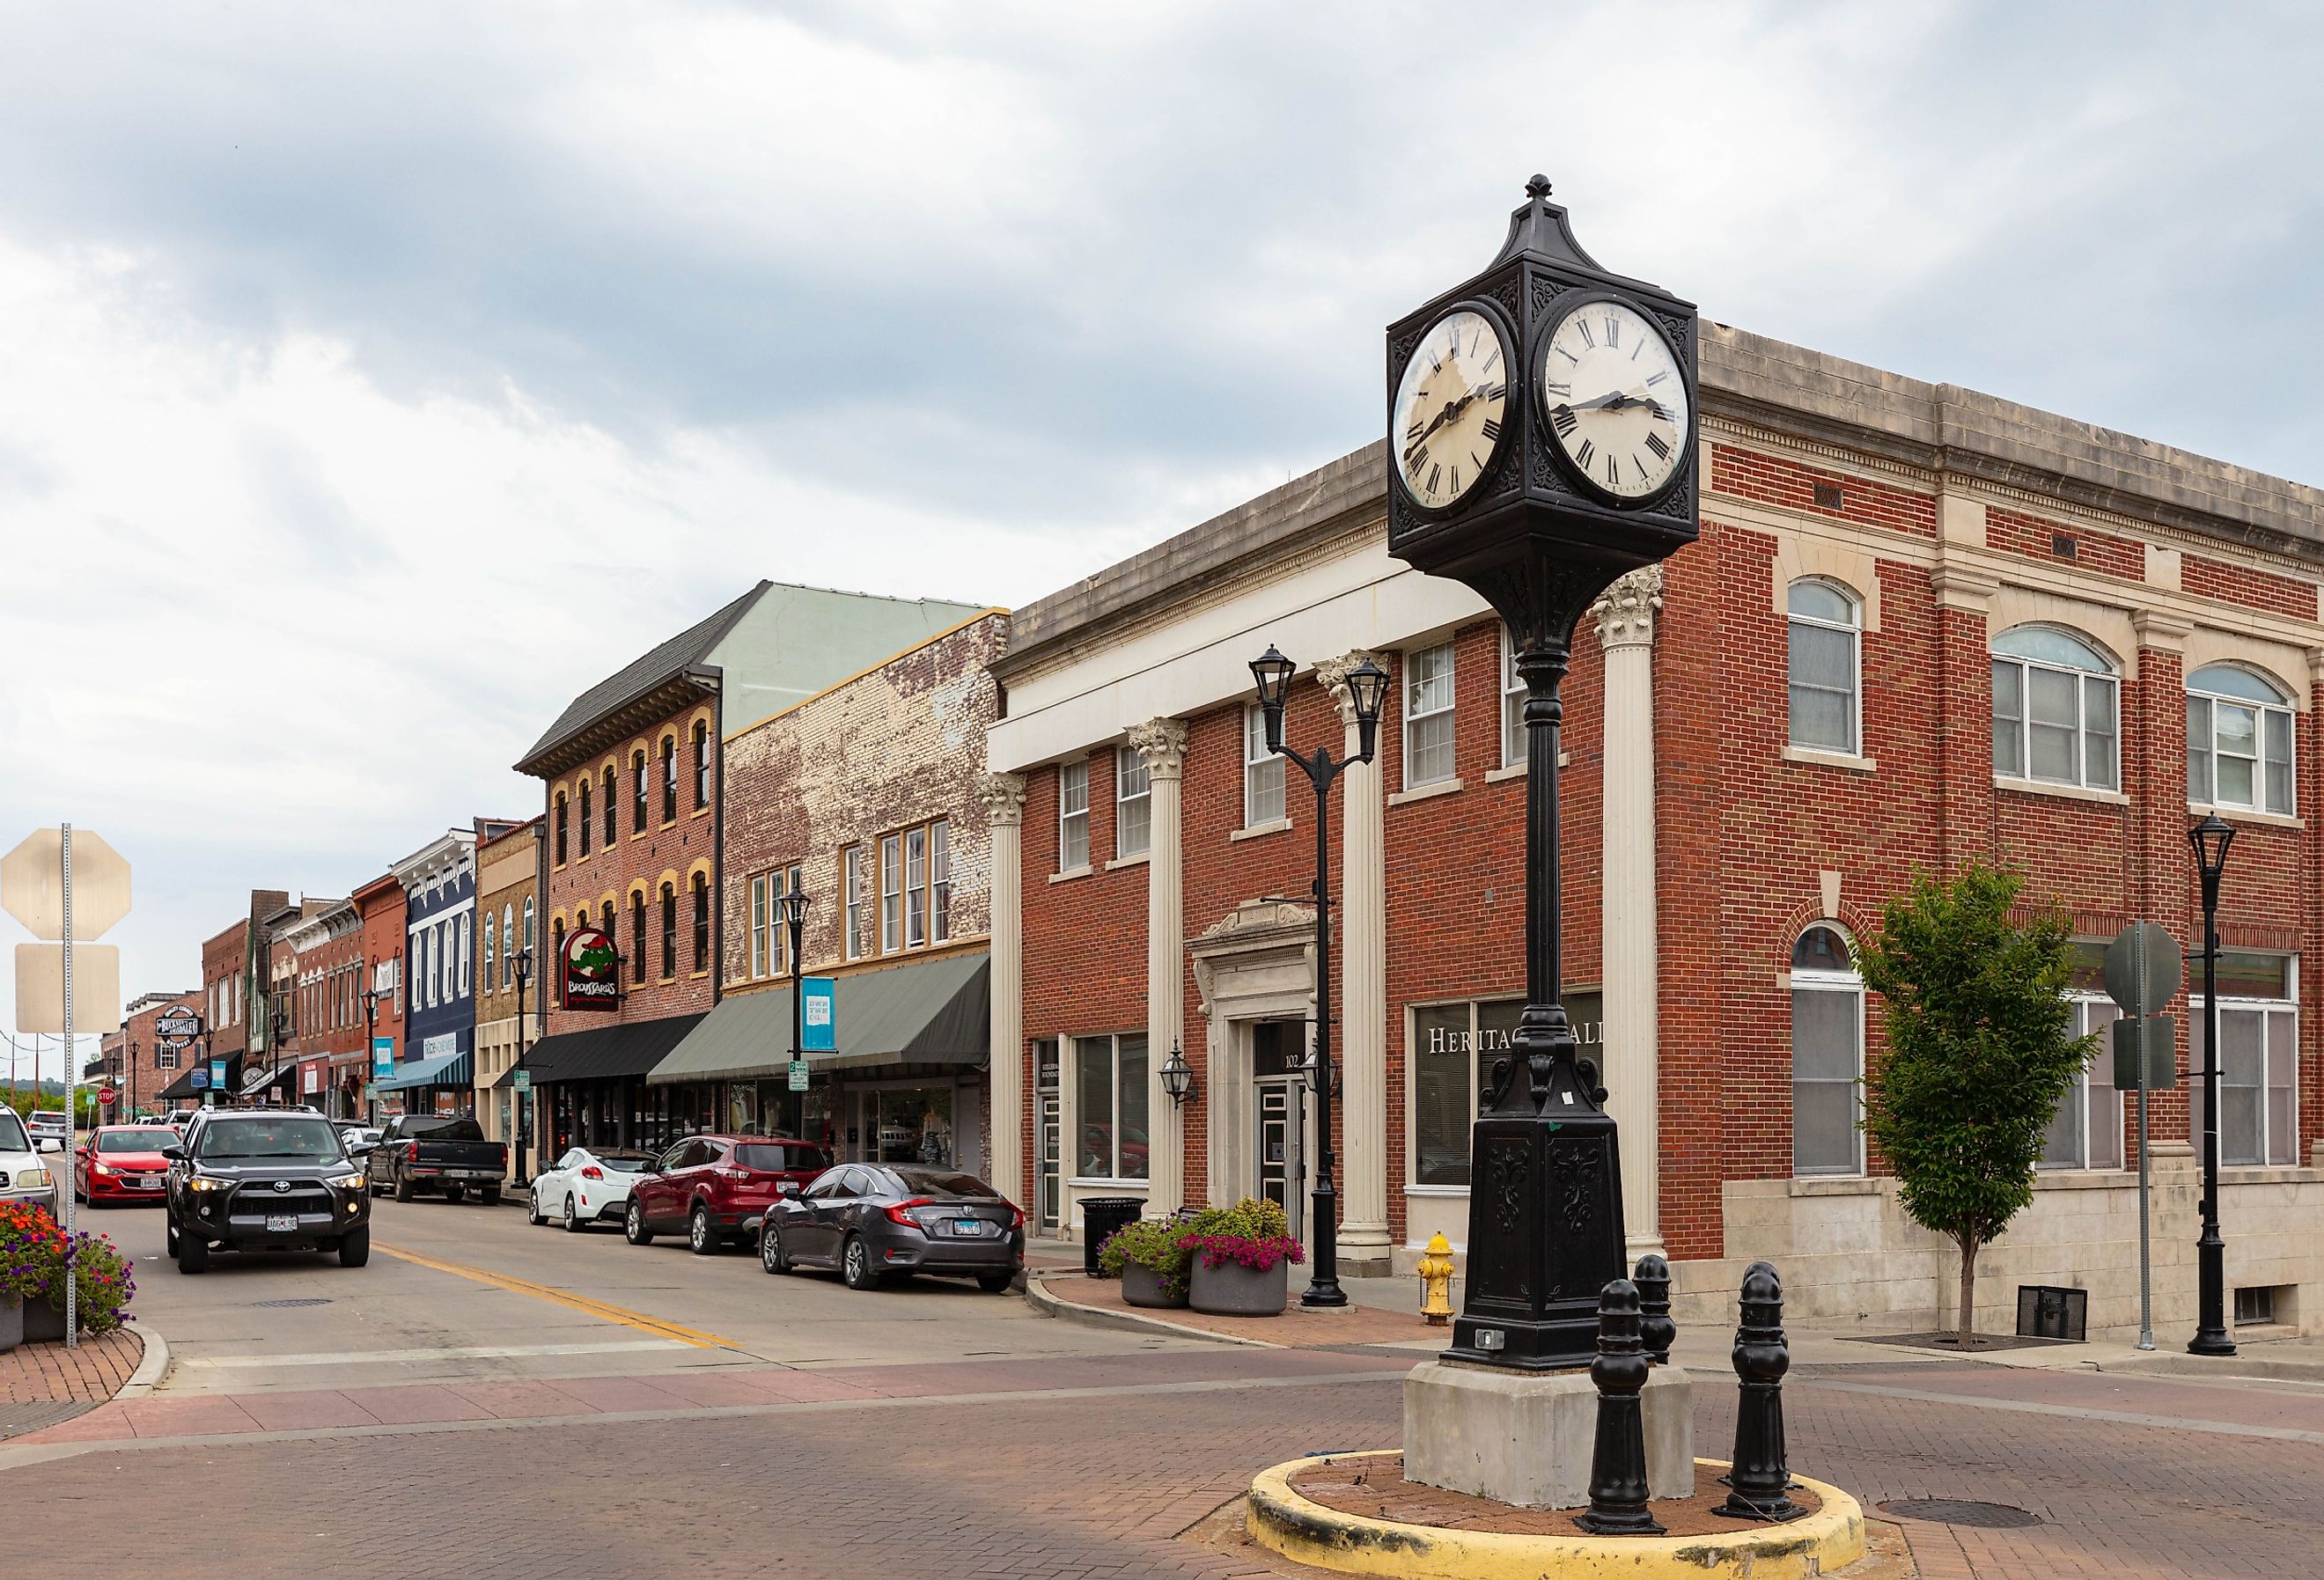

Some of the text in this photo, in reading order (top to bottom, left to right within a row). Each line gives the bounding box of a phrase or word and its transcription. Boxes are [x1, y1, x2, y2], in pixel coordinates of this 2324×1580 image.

[1576, 319, 1595, 351] XI
[1605, 317, 1620, 349] XII
[568, 981, 616, 996] BROUSSARD'S
[1428, 1026, 1521, 1055] HERITA
[790, 1062, 795, 1071] 2
[1285, 1055, 1299, 1069] 102
